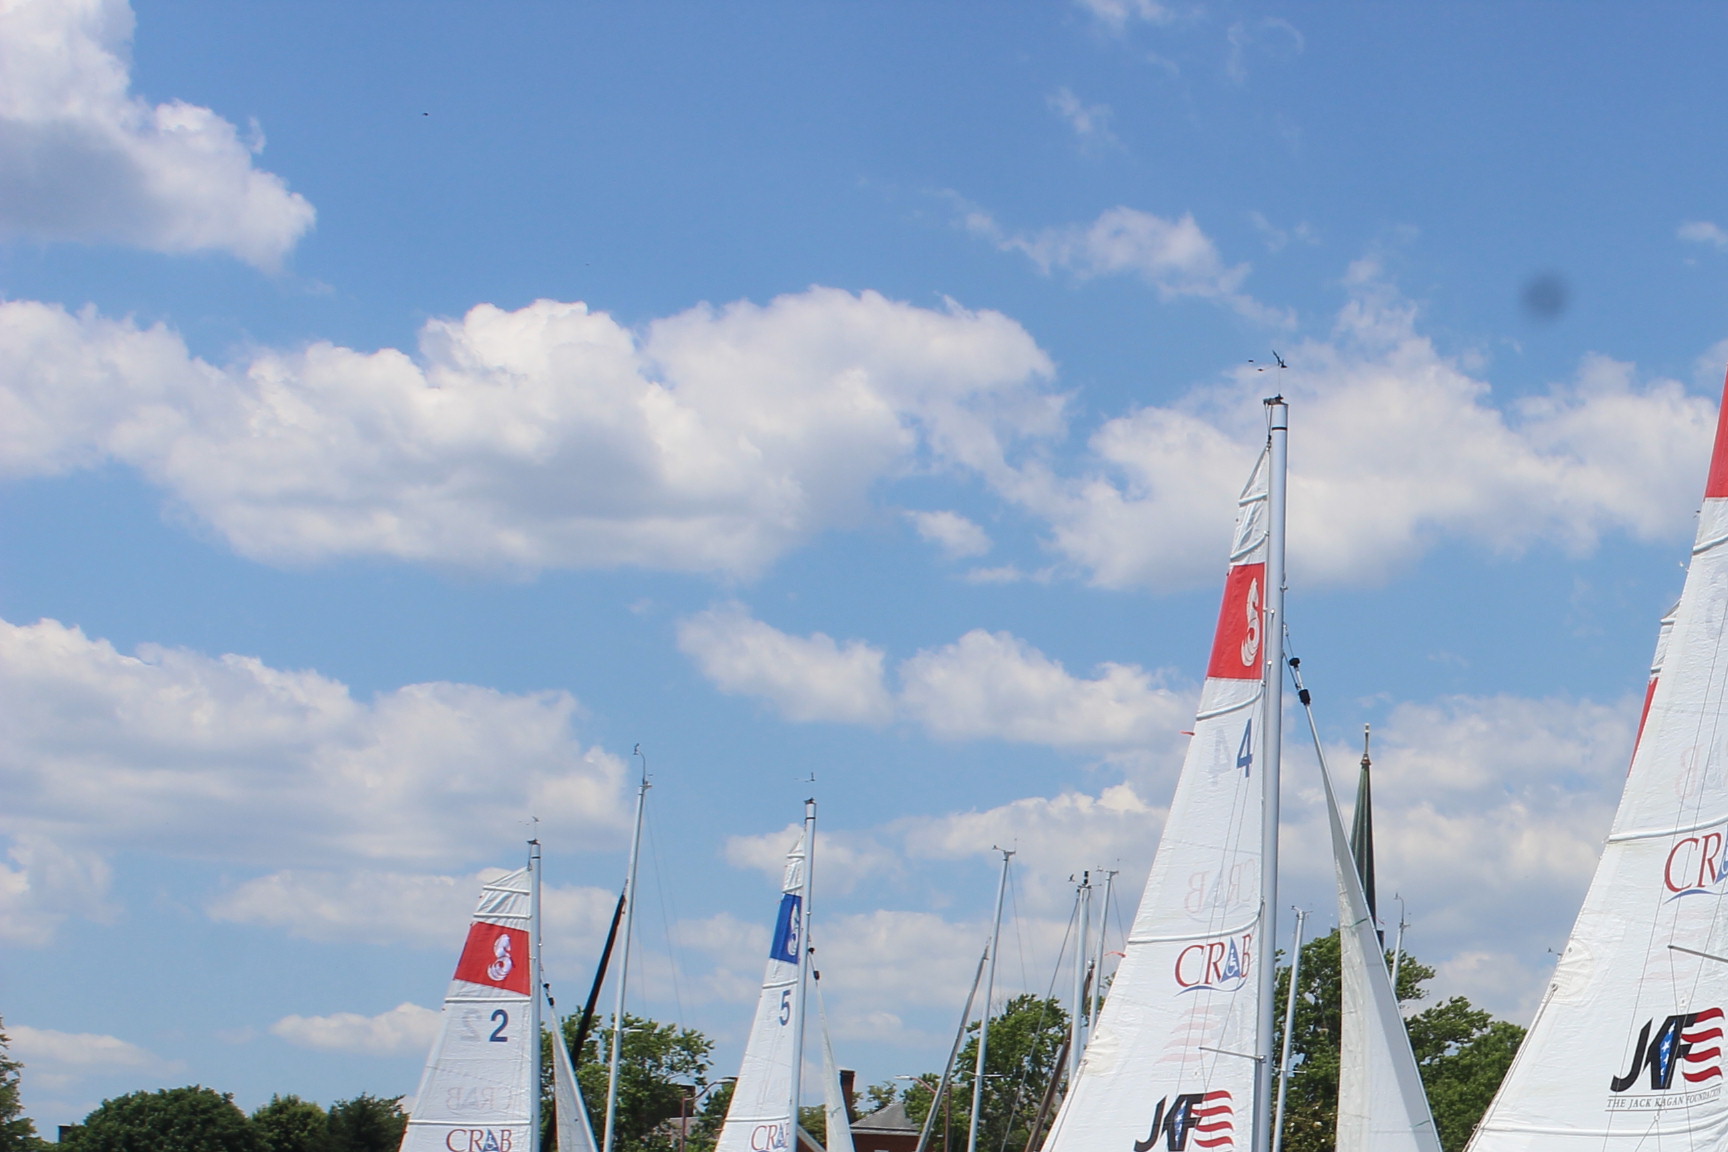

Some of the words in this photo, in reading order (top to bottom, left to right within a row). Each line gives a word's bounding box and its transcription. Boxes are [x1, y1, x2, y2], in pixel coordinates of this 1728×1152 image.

[1236, 718, 1253, 778] 4
[1175, 934, 1252, 988] CRAB
[489, 1009, 508, 1042] 2
[779, 990, 791, 1026] 5
